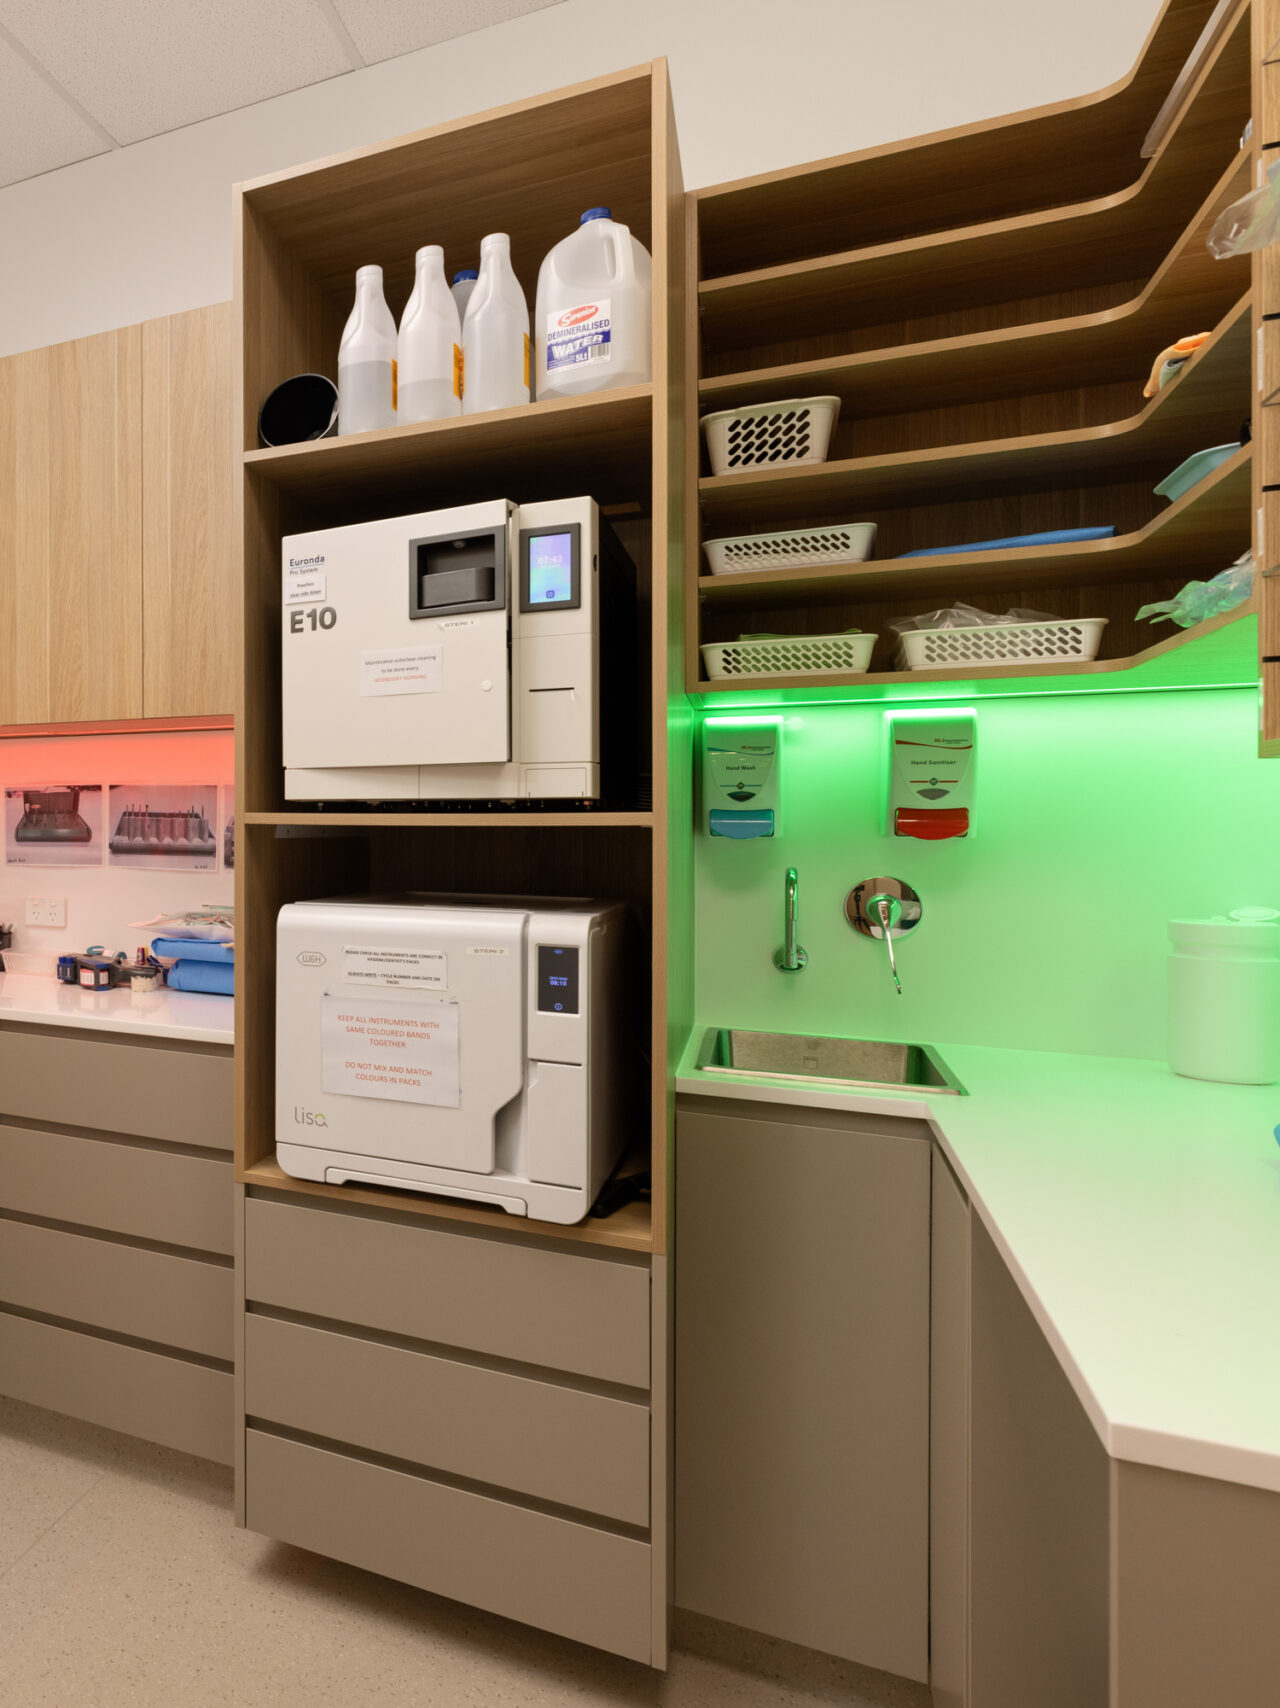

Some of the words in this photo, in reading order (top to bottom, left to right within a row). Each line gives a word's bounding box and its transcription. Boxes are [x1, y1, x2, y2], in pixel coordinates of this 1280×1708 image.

[547, 319, 610, 342] DEMINERALISED
[551, 334, 604, 360] WATER
[289, 555, 325, 567] Euronda
[299, 567, 319, 575] System
[290, 606, 337, 634] E10
[355, 1016, 367, 1024] ALL
[368, 1017, 418, 1028] INSTRUMENTS
[420, 1021, 440, 1029] WITH
[345, 1026, 365, 1034] SAME
[366, 1027, 405, 1038] COLOURED
[406, 1031, 431, 1040] BANDS
[345, 1061, 356, 1069] DO
[357, 1062, 372, 1070] NOT
[373, 1063, 387, 1071] MIX
[388, 1066, 404, 1074] AND
[406, 1067, 432, 1077] MATCH
[355, 1073, 388, 1083] COLOURS
[389, 1076, 397, 1084] IN
[398, 1078, 421, 1087] PACKS
[294, 1106, 328, 1128] lisa
